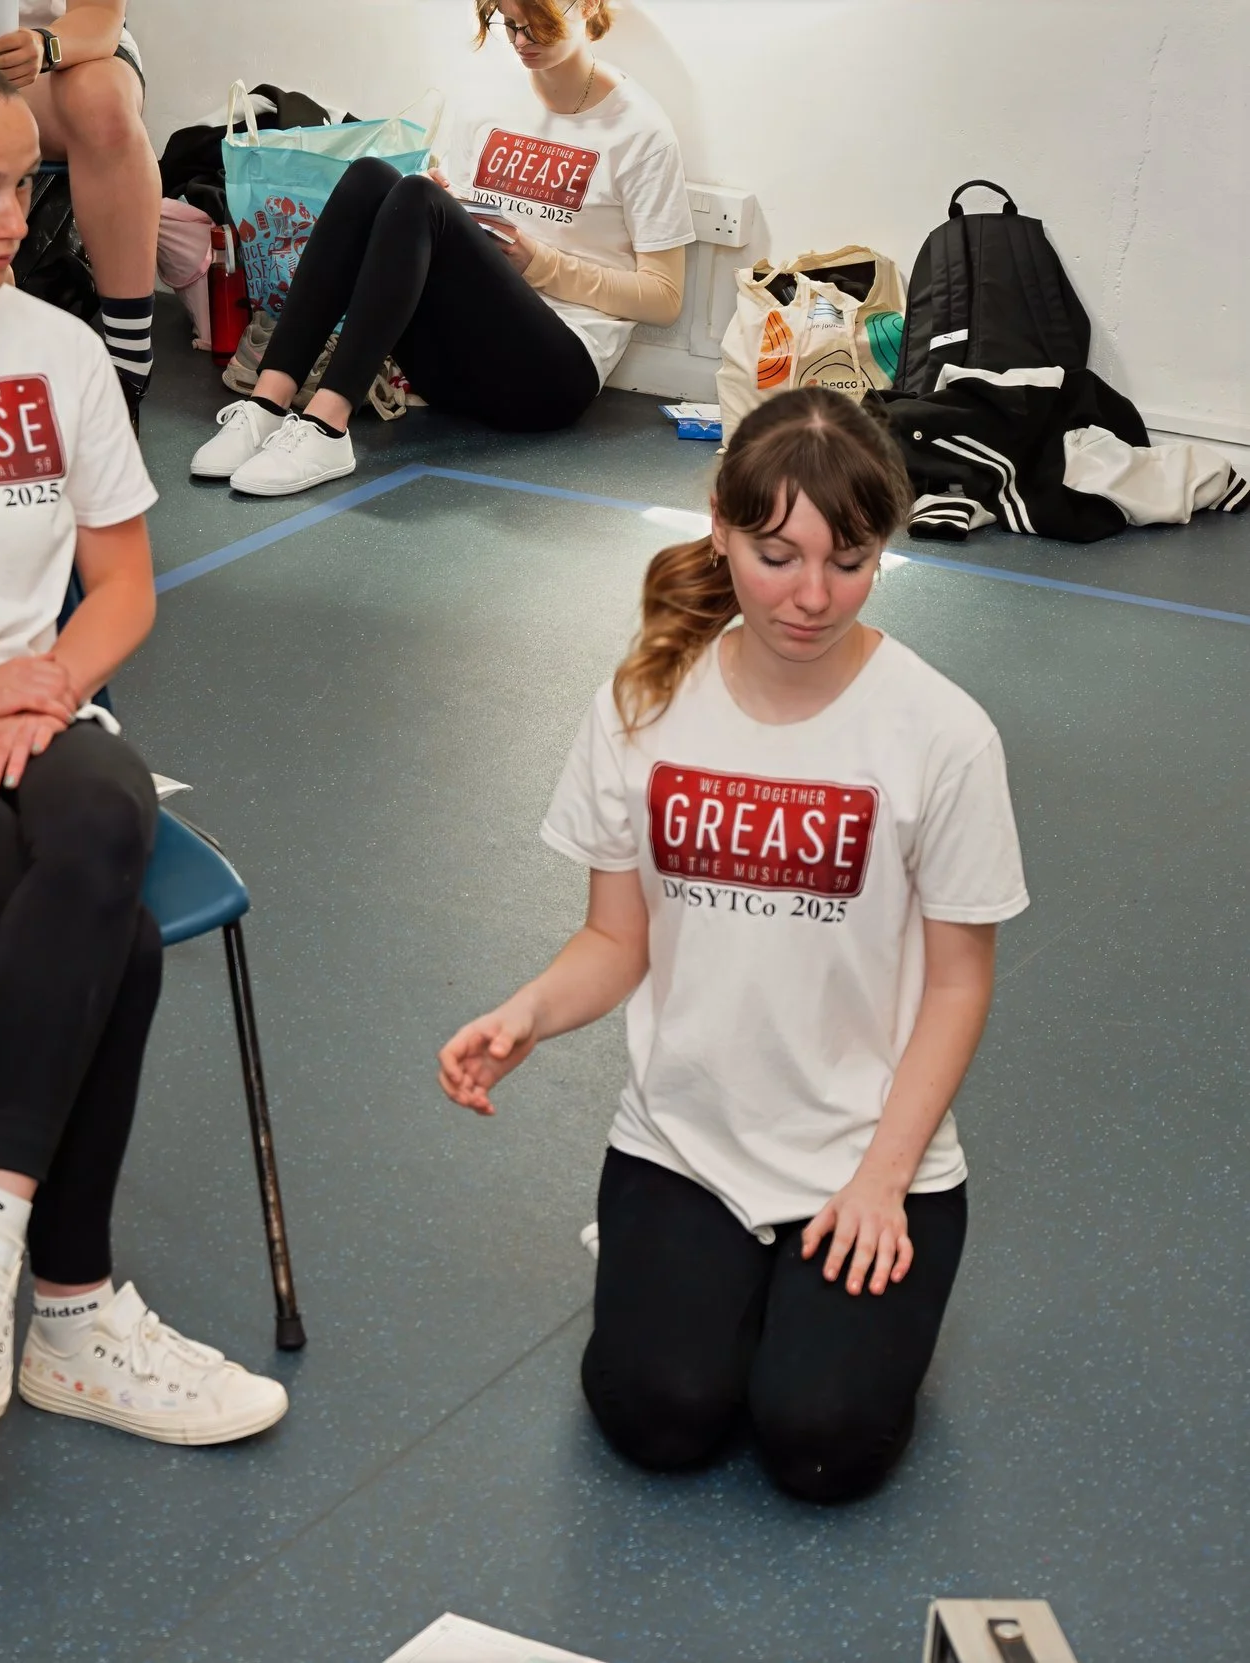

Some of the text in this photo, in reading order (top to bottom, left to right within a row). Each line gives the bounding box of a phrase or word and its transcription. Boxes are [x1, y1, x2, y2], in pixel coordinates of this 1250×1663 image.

[514, 139, 575, 160] WE GO TOGETHER
[487, 146, 587, 194] GREASE
[494, 179, 511, 190] THE
[516, 185, 555, 201] MUSICAL
[472, 190, 573, 224] DOSYTCo 2025
[3, 482, 63, 508] 2025
[699, 777, 827, 807] WE GO TOGETHER
[663, 792, 860, 868] GREASE
[687, 856, 722, 875] THE
[734, 862, 817, 887] MUSICAL
[791, 896, 849, 923] 2025
